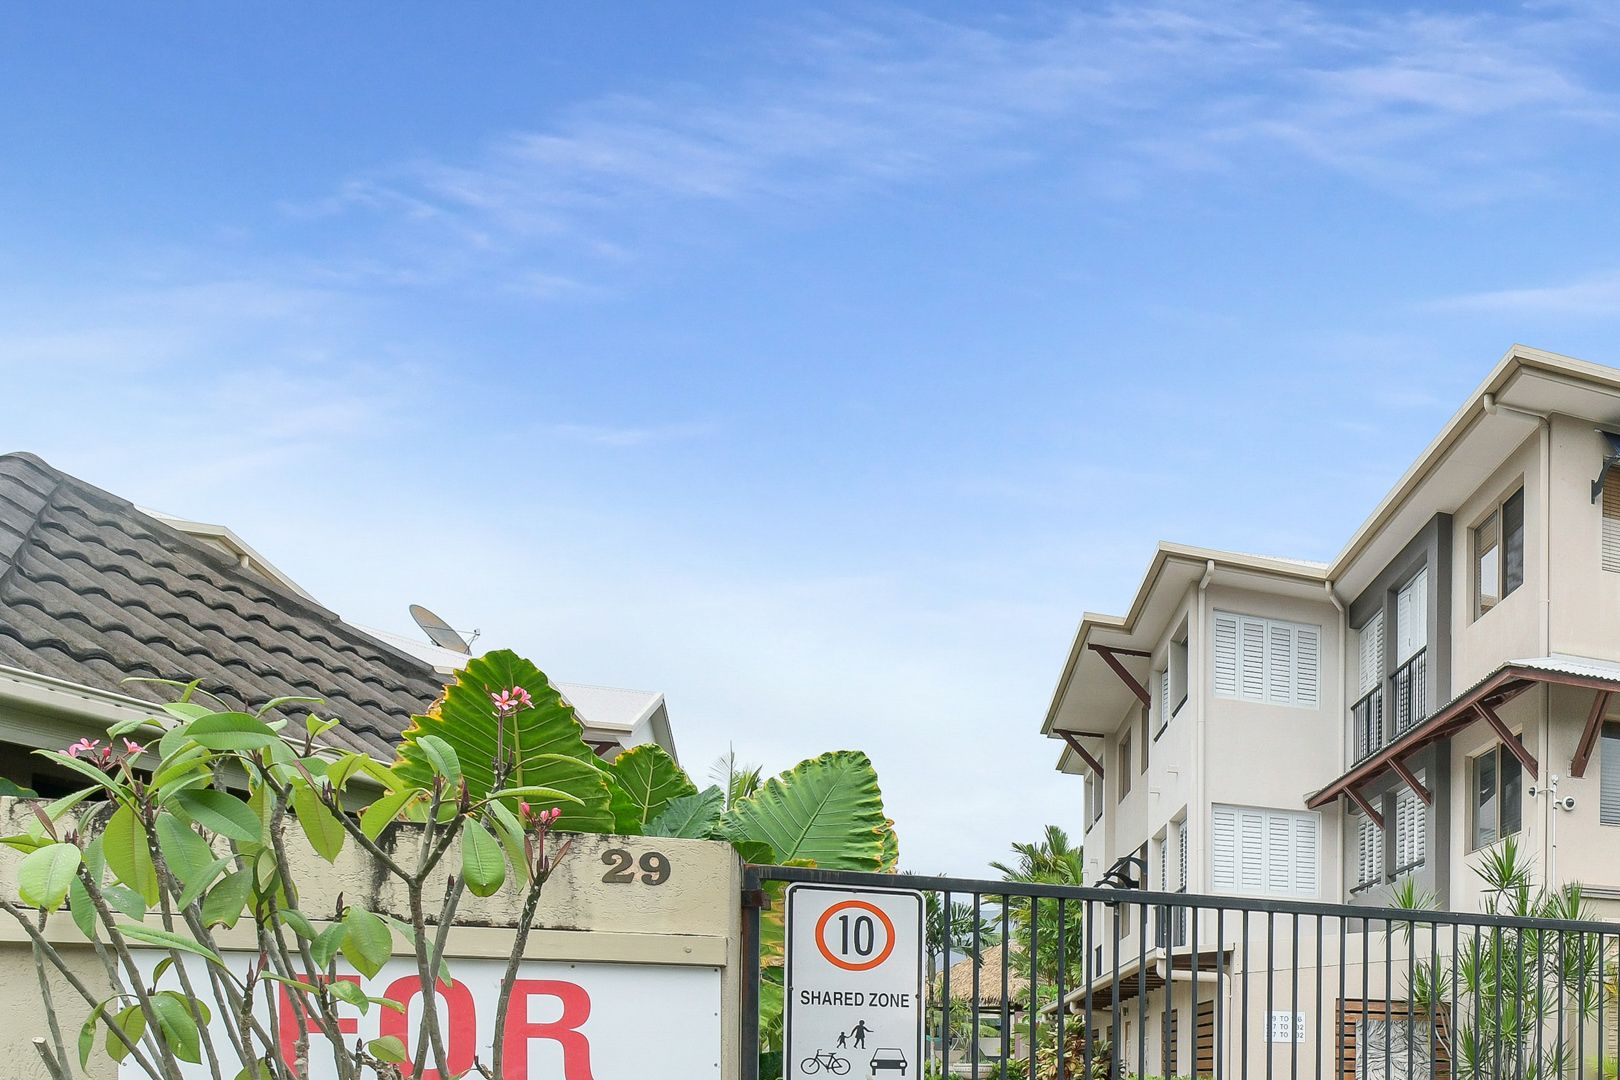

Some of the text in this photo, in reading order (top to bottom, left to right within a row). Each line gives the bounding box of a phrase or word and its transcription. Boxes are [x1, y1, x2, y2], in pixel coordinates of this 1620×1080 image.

[602, 848, 671, 886] 29
[838, 914, 874, 957] 10
[800, 990, 910, 1008] SHARED ZONE
